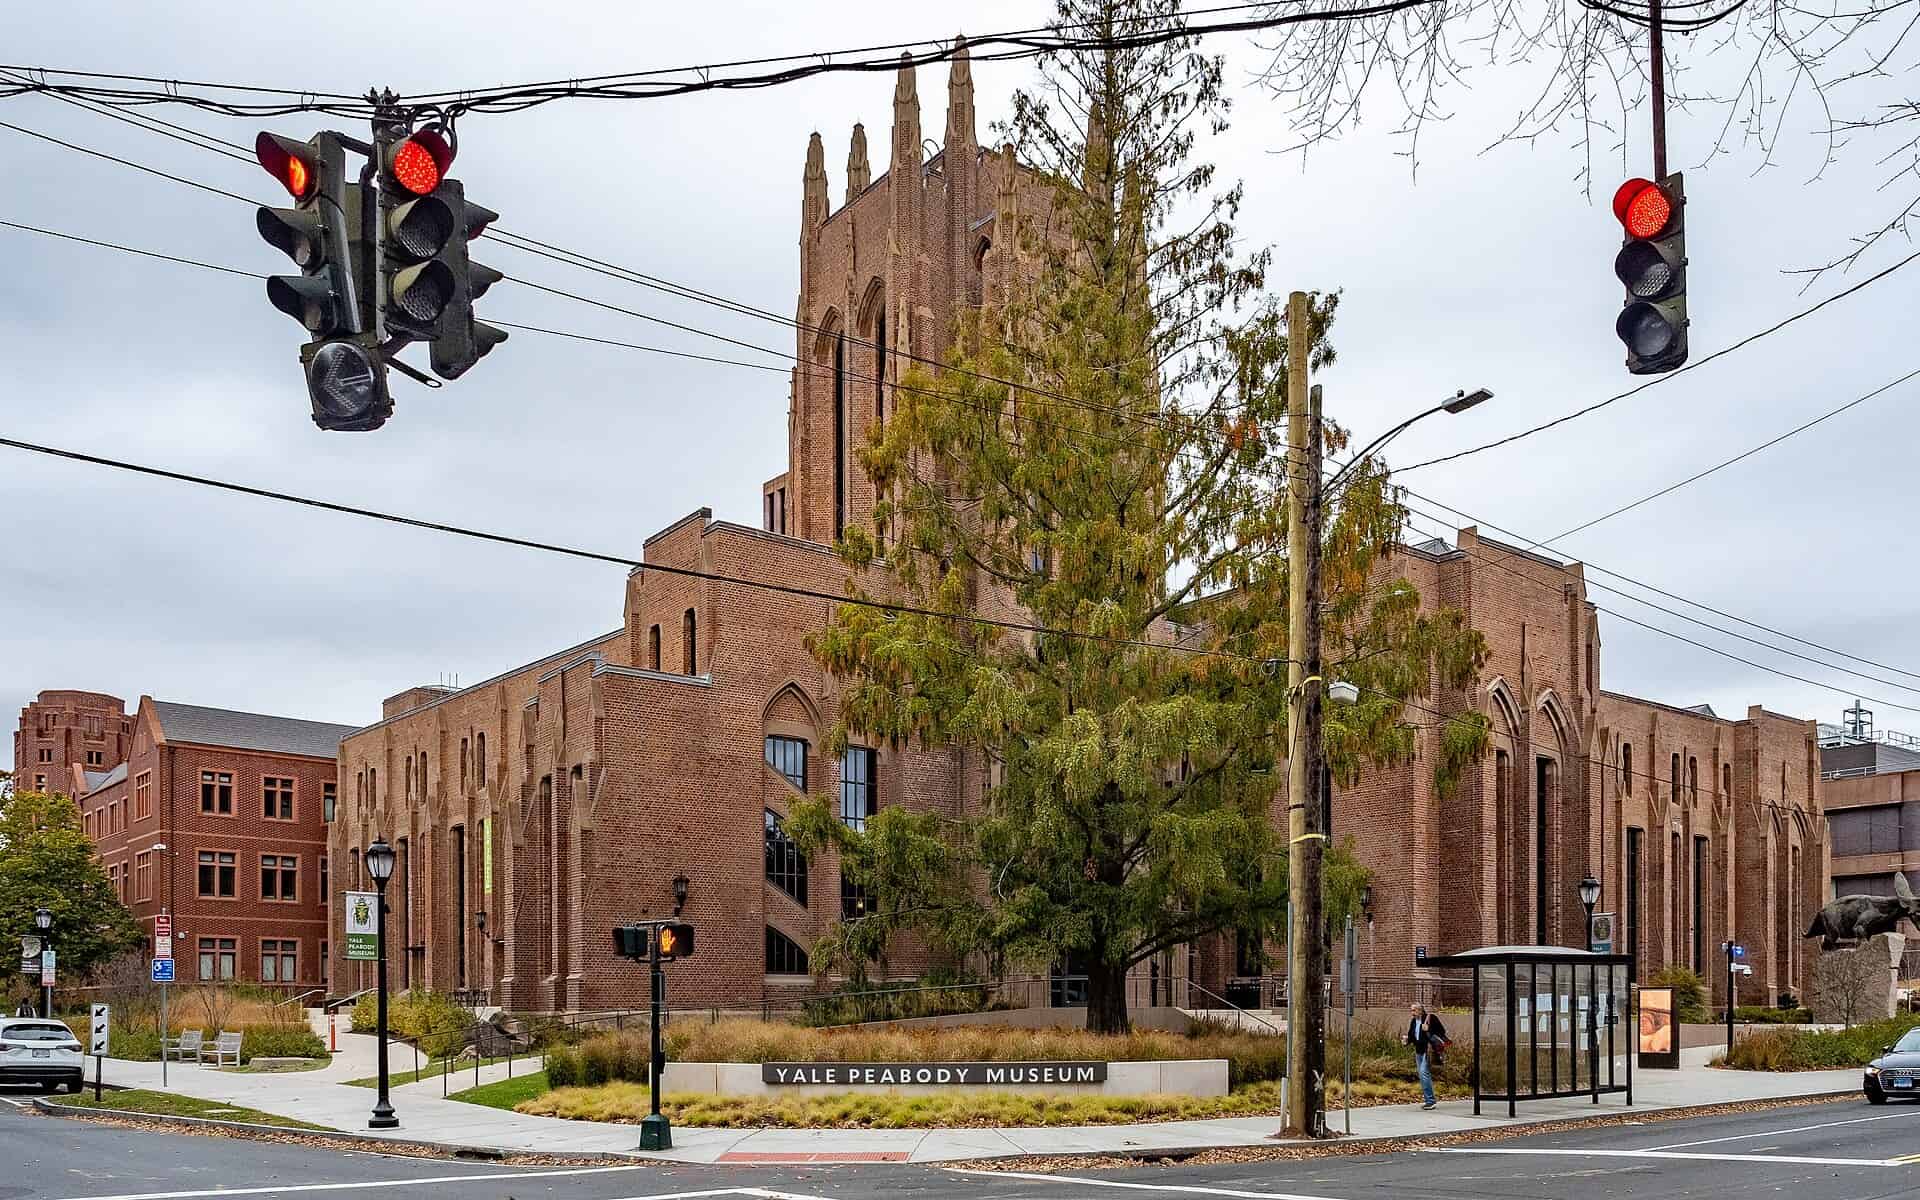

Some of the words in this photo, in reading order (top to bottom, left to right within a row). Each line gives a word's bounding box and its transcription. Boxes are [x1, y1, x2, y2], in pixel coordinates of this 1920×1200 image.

[776, 1068, 836, 1083] YALE
[849, 1068, 969, 1083] PEABODY
[986, 1066, 1095, 1083] MUSEUM
